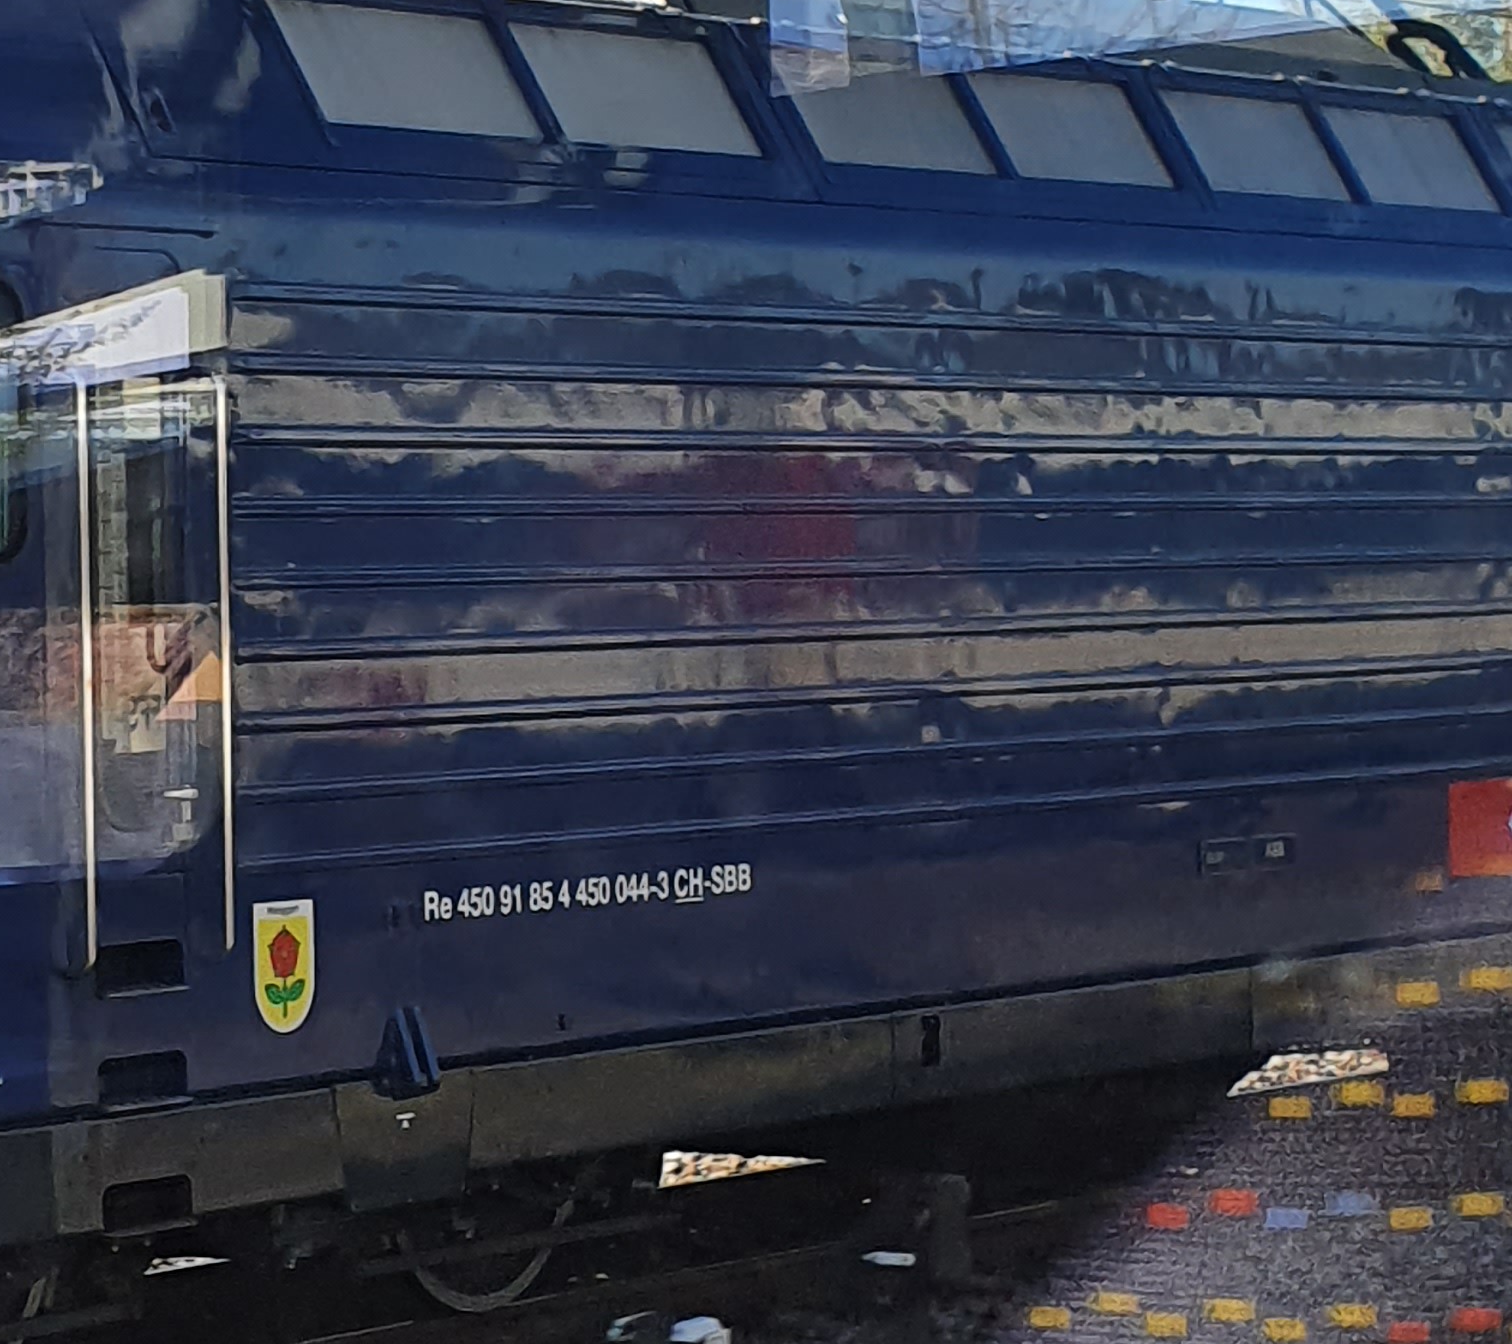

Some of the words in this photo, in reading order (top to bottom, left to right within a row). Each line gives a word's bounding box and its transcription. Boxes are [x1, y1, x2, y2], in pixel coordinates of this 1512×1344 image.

[424, 890, 452, 921] Re
[457, 885, 495, 918] 450
[499, 884, 522, 915] 91
[529, 881, 553, 912] 85
[558, 879, 570, 908] 4
[575, 876, 610, 906] 450
[614, 869, 668, 904] 044-3
[674, 863, 752, 903] CH-SBB
